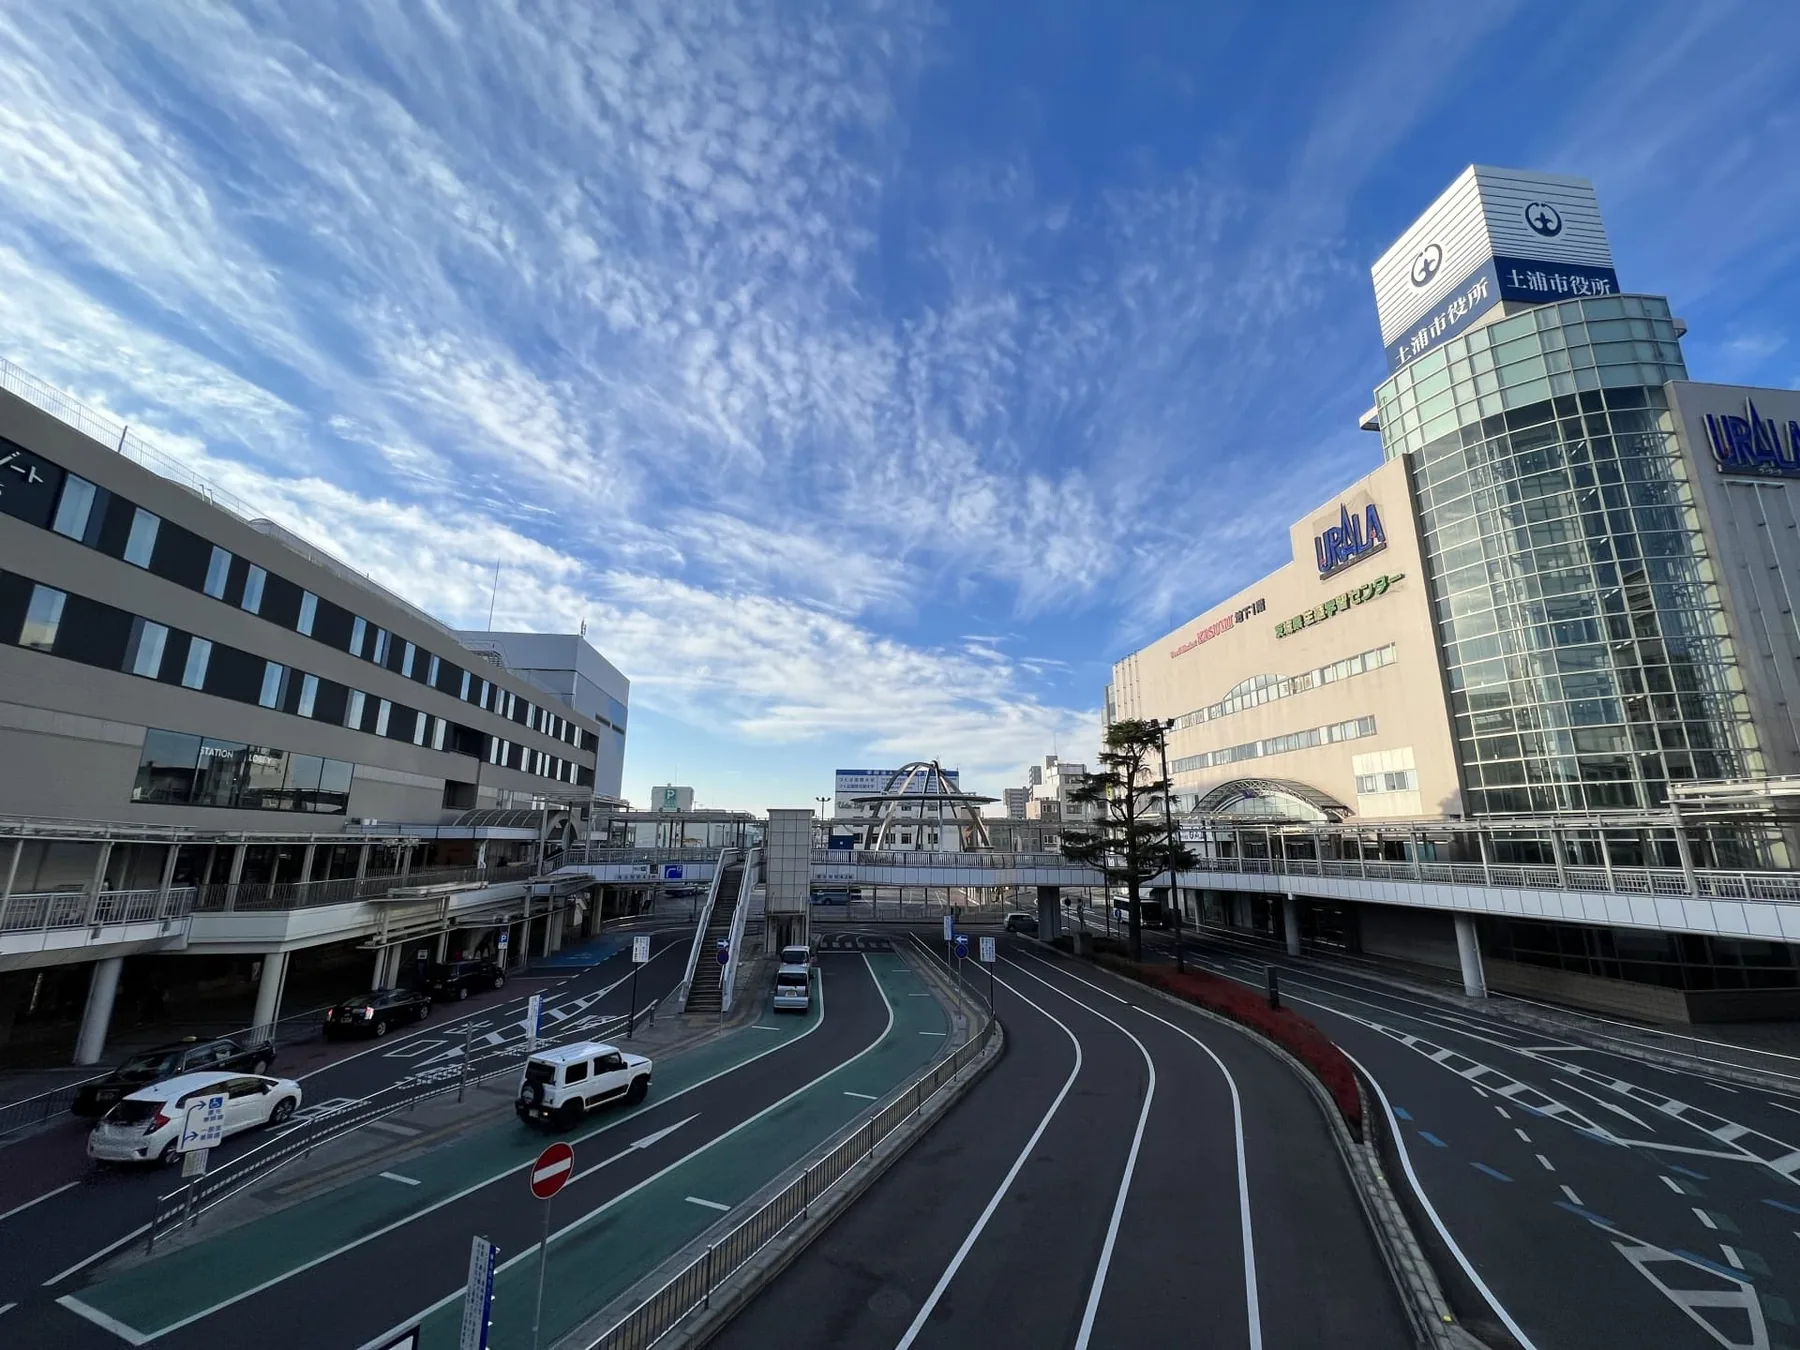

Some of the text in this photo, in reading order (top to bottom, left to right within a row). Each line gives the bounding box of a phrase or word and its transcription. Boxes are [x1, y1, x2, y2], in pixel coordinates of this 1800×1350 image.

[1506, 269, 1610, 296] 土浦市役所
[1395, 276, 1489, 368] 土浦市役所
[1314, 502, 1386, 572] URALA
[200, 746, 234, 759] STATION
[667, 789, 675, 800] P
